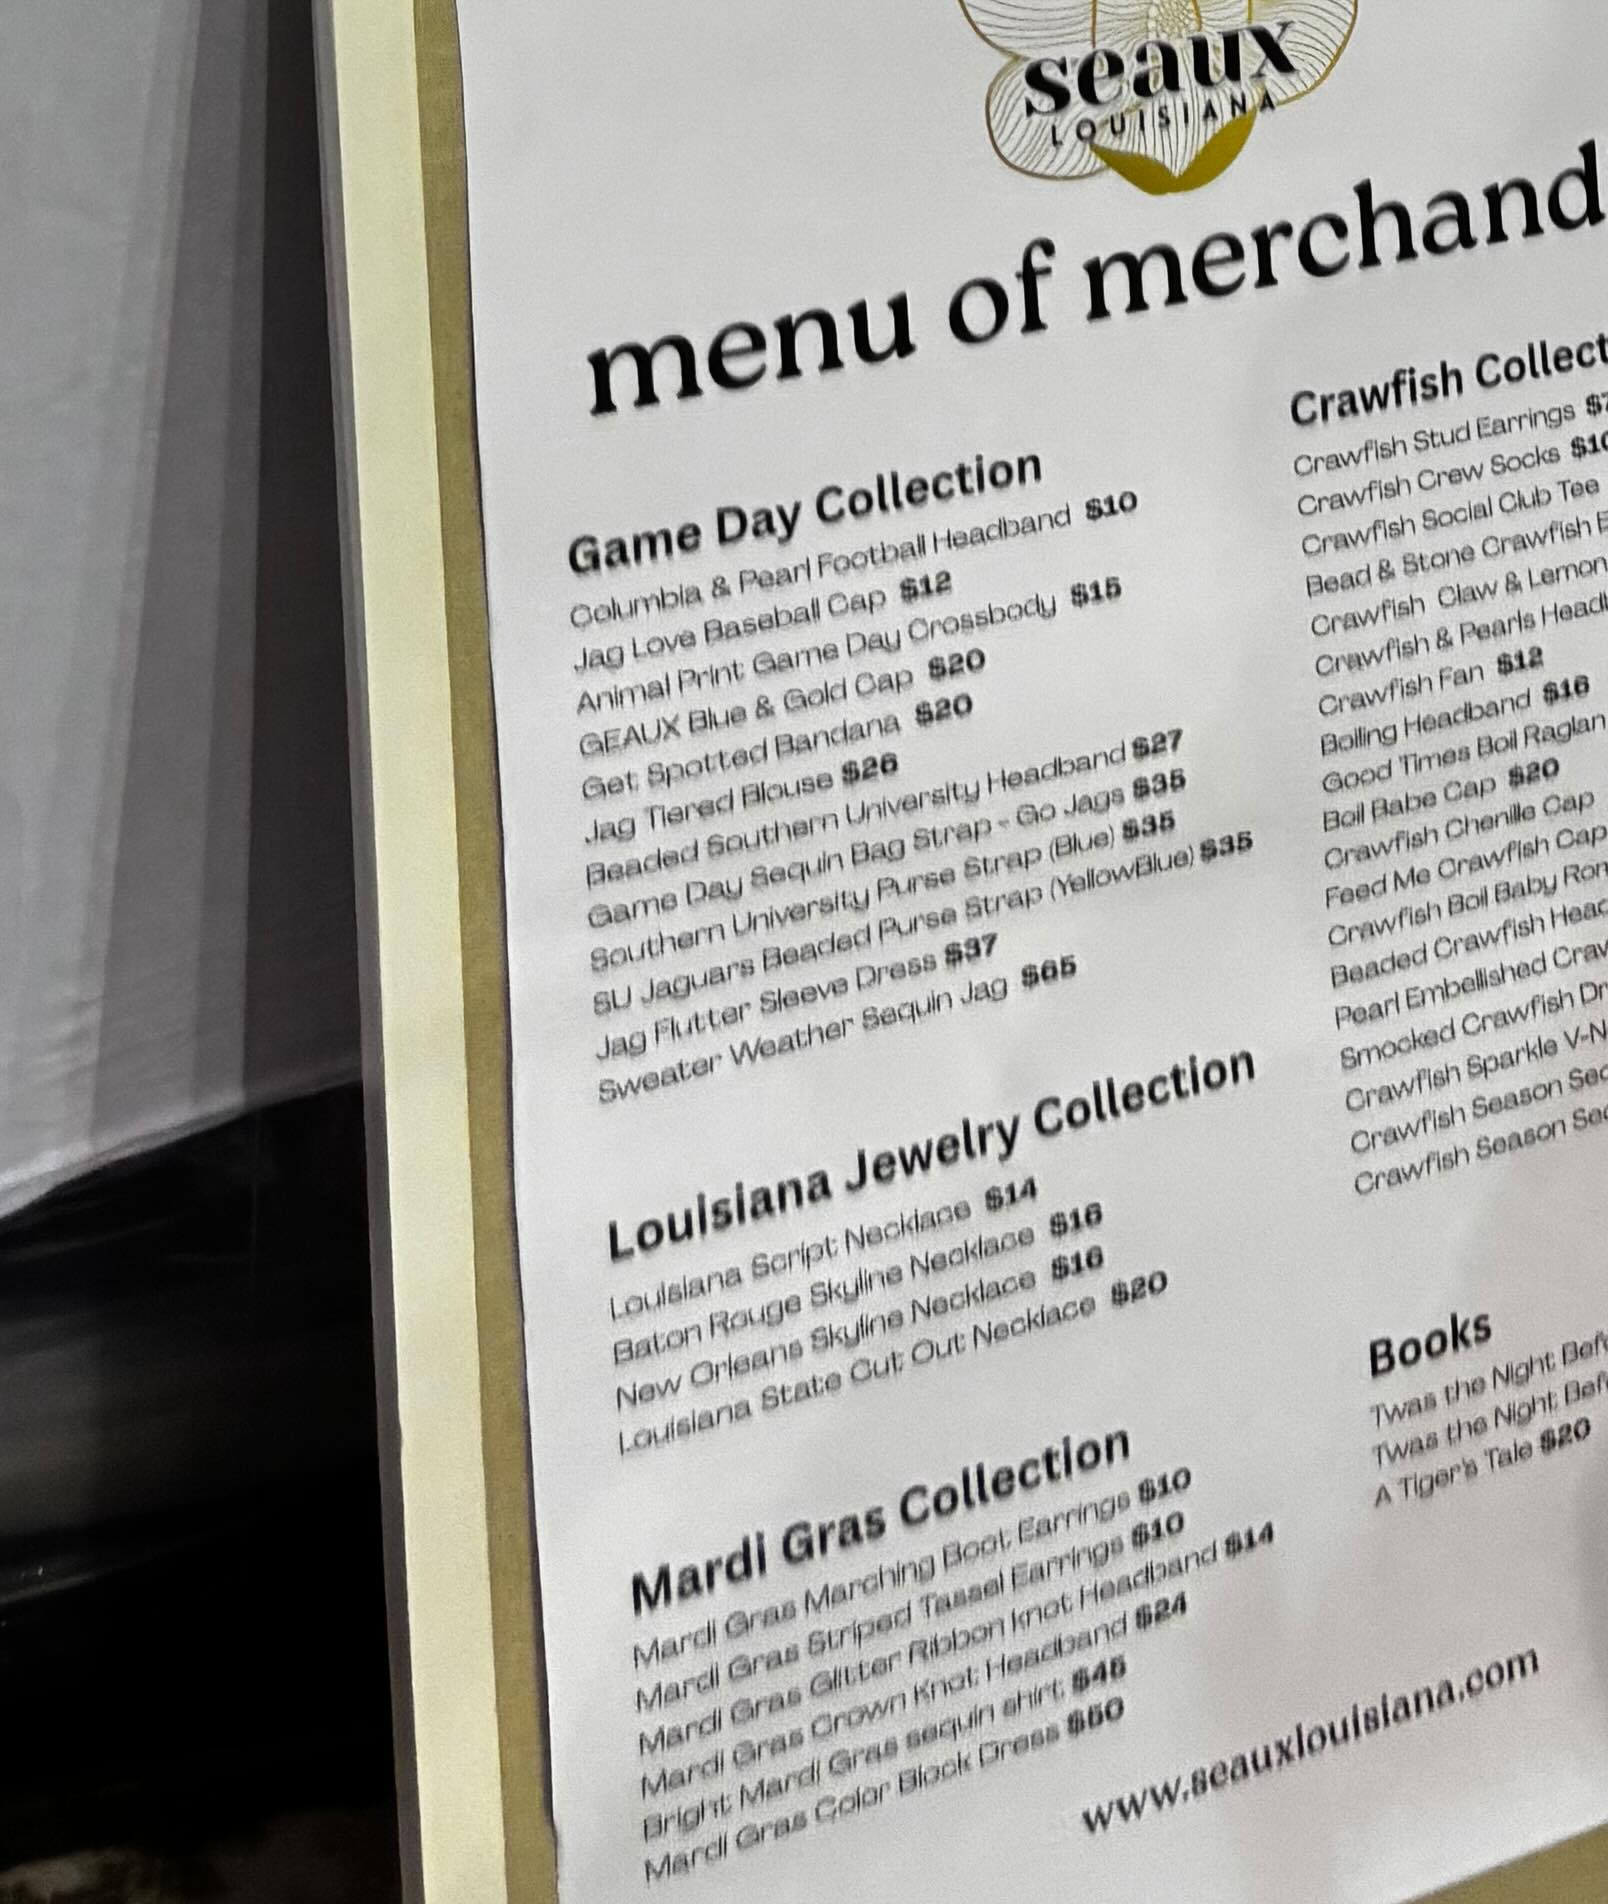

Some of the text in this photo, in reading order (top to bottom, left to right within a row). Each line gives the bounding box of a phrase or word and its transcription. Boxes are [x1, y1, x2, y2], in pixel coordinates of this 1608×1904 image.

[1025, 21, 1298, 119] seaux
[1053, 91, 1275, 146] LOUISIANA
[587, 291, 917, 419] menu
[948, 236, 1055, 347] of
[1291, 359, 1463, 429] Crawfish
[1294, 435, 1408, 480] Crawfish
[1413, 419, 1471, 454] Stud
[1476, 403, 1576, 441] Earrings
[1298, 474, 1411, 518] Crawfish
[1417, 462, 1483, 492] Crew
[1491, 444, 1561, 477] Socks
[568, 453, 1041, 578] Game Day Collection
[570, 583, 704, 633] Columbia
[711, 575, 732, 603] &
[739, 555, 811, 595] Pearl
[818, 532, 926, 579] Football
[933, 502, 1071, 555] Headband
[574, 645, 624, 677] Jag
[632, 629, 696, 663] Love
[704, 596, 820, 648] Baseball
[828, 589, 886, 618] Cap
[579, 712, 681, 761] GEAUX
[688, 705, 747, 738] Blue
[755, 693, 776, 721] &
[783, 676, 847, 715] Gold
[855, 669, 913, 701] Cap
[1322, 757, 1392, 795] Good
[1398, 745, 1471, 777] Times
[1477, 727, 1518, 762] Boil
[1523, 713, 1606, 750] Raglan
[586, 838, 699, 892] Beaded
[706, 812, 839, 861] Southern
[845, 779, 980, 828] University
[987, 739, 1126, 796] Headband
[1328, 900, 1442, 951] Crawfish
[1448, 884, 1488, 919] Boil
[1495, 872, 1557, 907] Baby
[599, 1053, 722, 1106] Sweater
[729, 1016, 854, 1067] Weather
[862, 989, 953, 1033] Sequin
[960, 977, 1008, 1008] Jag
[1340, 1016, 1456, 1073] Smocked
[1461, 988, 1574, 1038] Crawfish
[1346, 1061, 1461, 1114] Crawfish
[1467, 1034, 1558, 1081] Sparkle
[609, 1050, 1255, 1265] Louisiana Jewelry Collection
[1370, 1311, 1492, 1380] Books
[632, 1429, 1129, 1618] Mardi Gras Collection
[1082, 1648, 1539, 1836] www.seauxlouisiana.com
